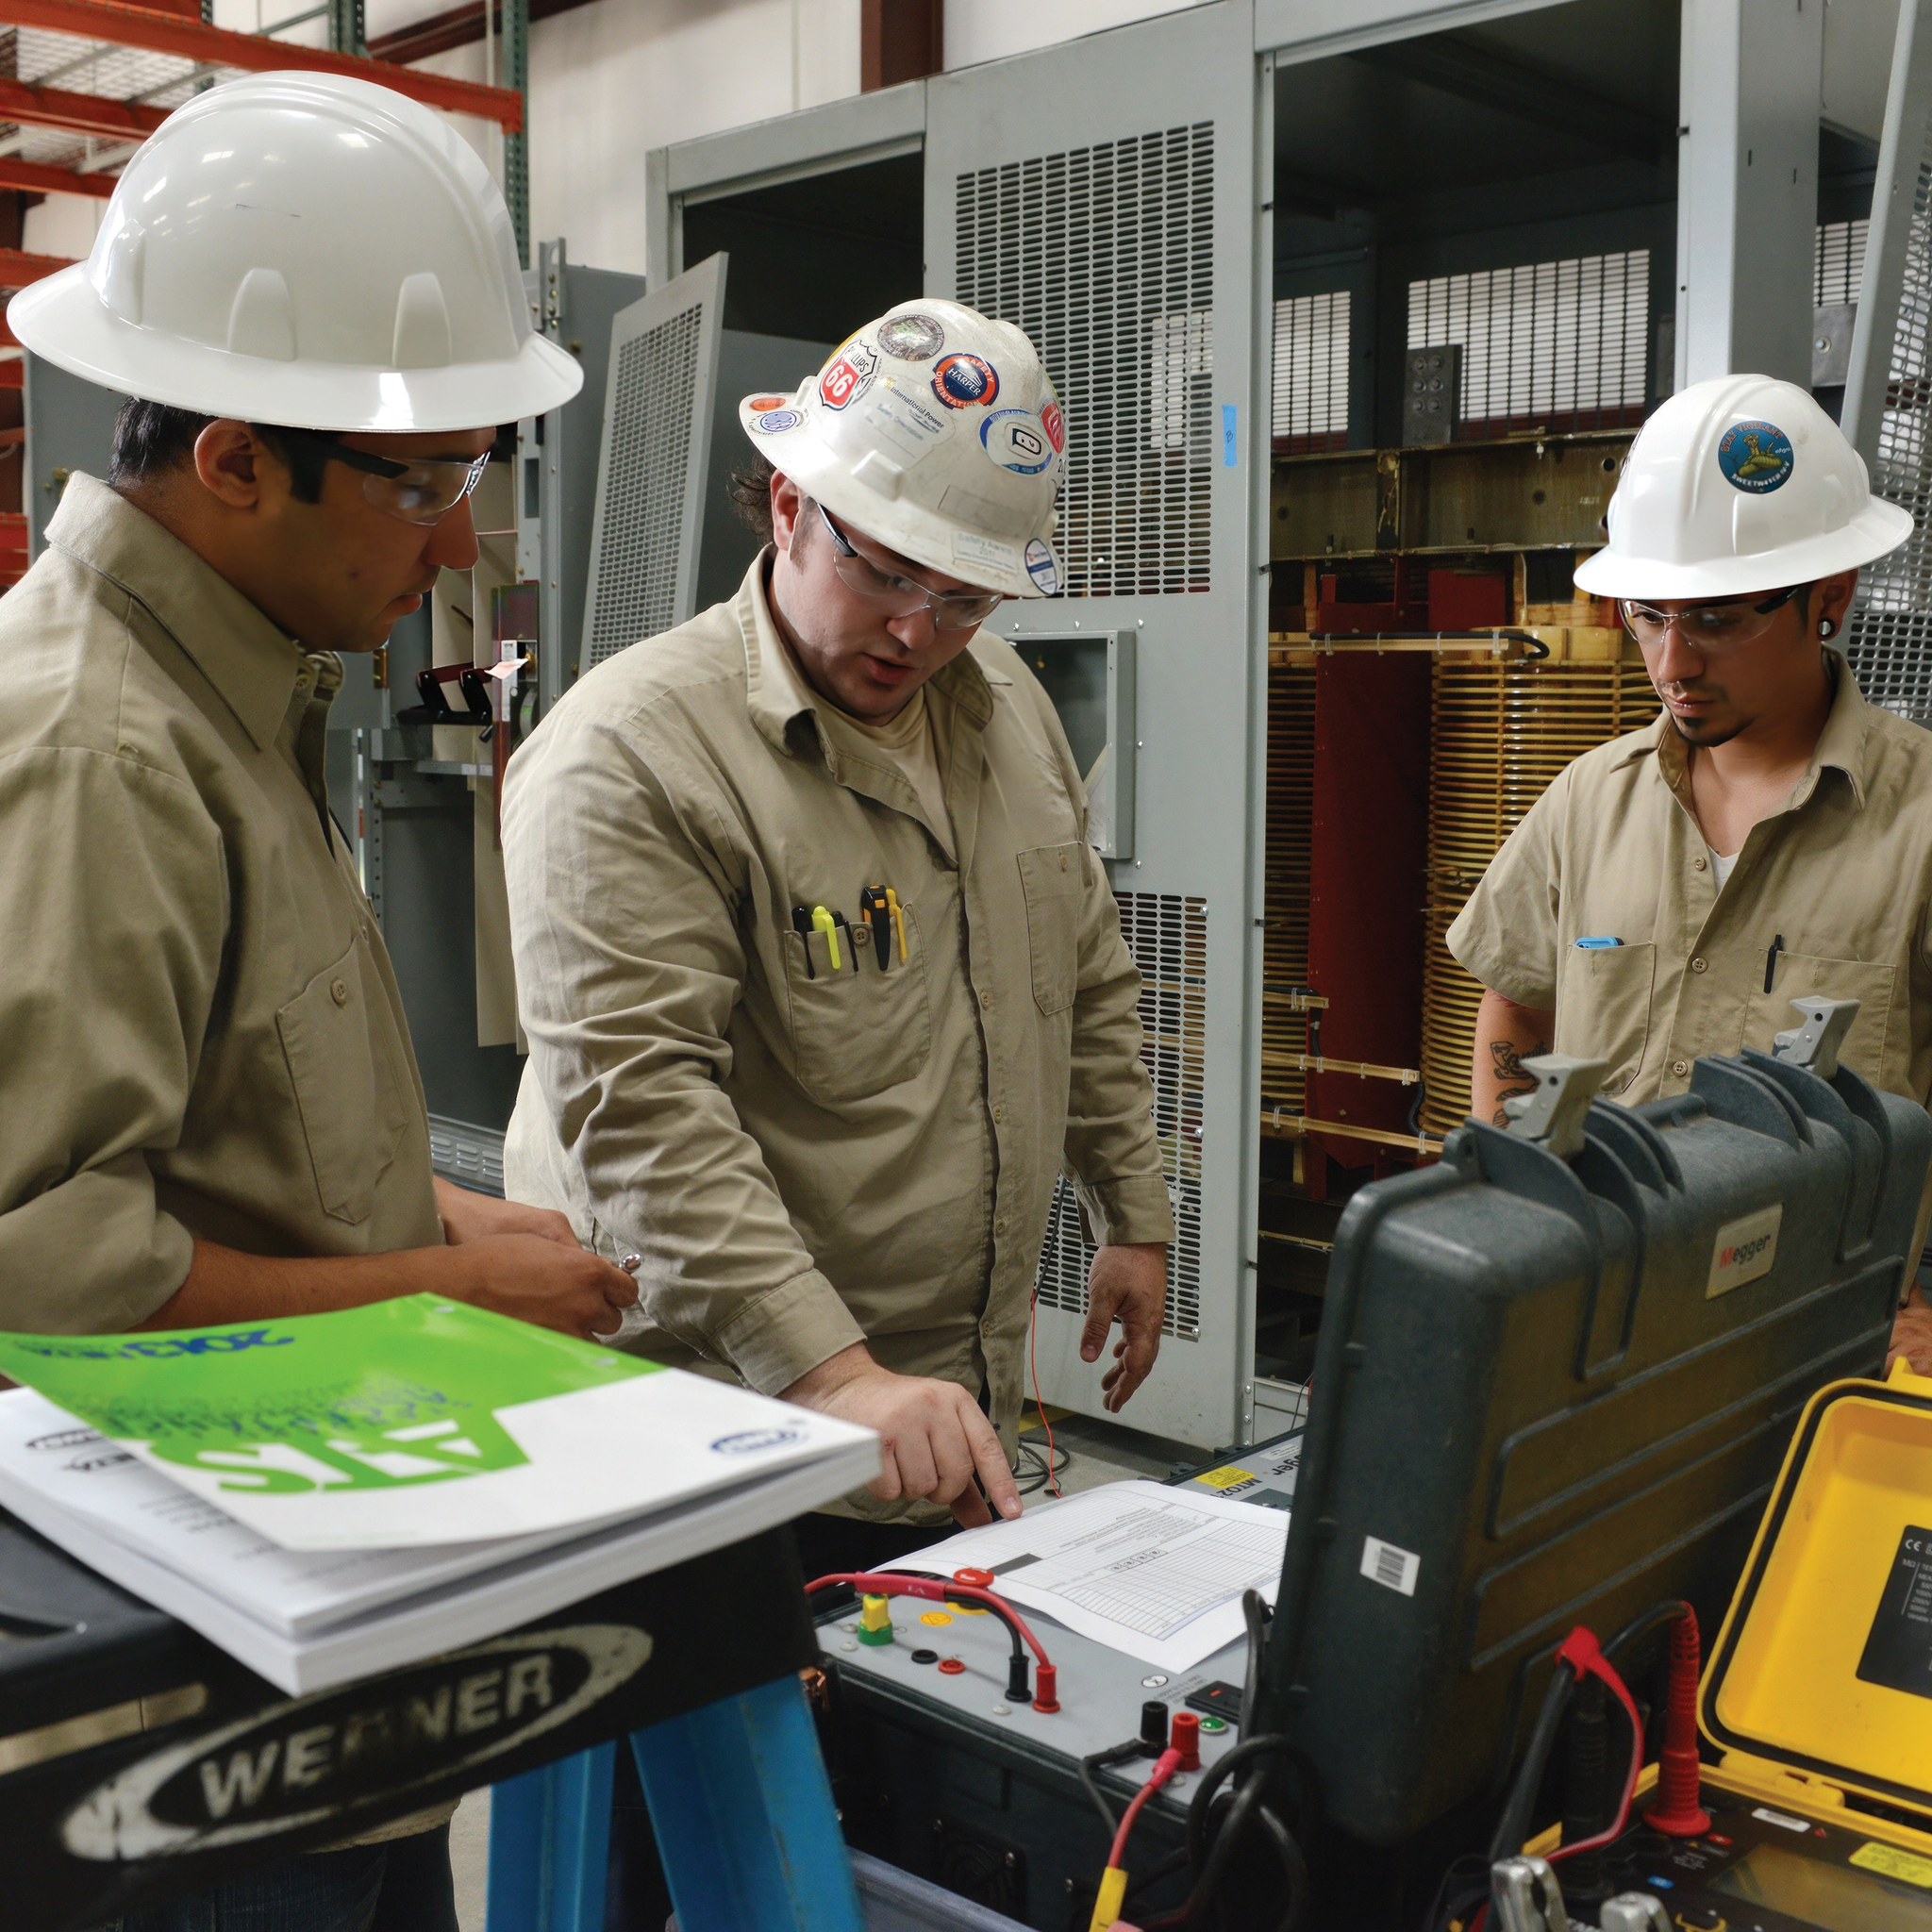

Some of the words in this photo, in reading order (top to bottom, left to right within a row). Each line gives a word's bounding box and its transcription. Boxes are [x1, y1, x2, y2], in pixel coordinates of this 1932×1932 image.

[845, 345, 869, 373] PILLIPS
[963, 357, 994, 383] SAFETY
[825, 364, 853, 397] 66
[935, 371, 979, 408] ORIENTATION
[948, 368, 981, 396] HARPER
[890, 386, 926, 414] International
[924, 411, 945, 429] Power
[1720, 430, 1738, 452] STAY
[1735, 422, 1784, 440] VIGILANT
[1731, 473, 1782, 487] SWEETWATER
[1719, 1234, 1771, 1269] Megger
[148, 1415, 531, 1493] ATS
[199, 1654, 555, 1819] WERNER
